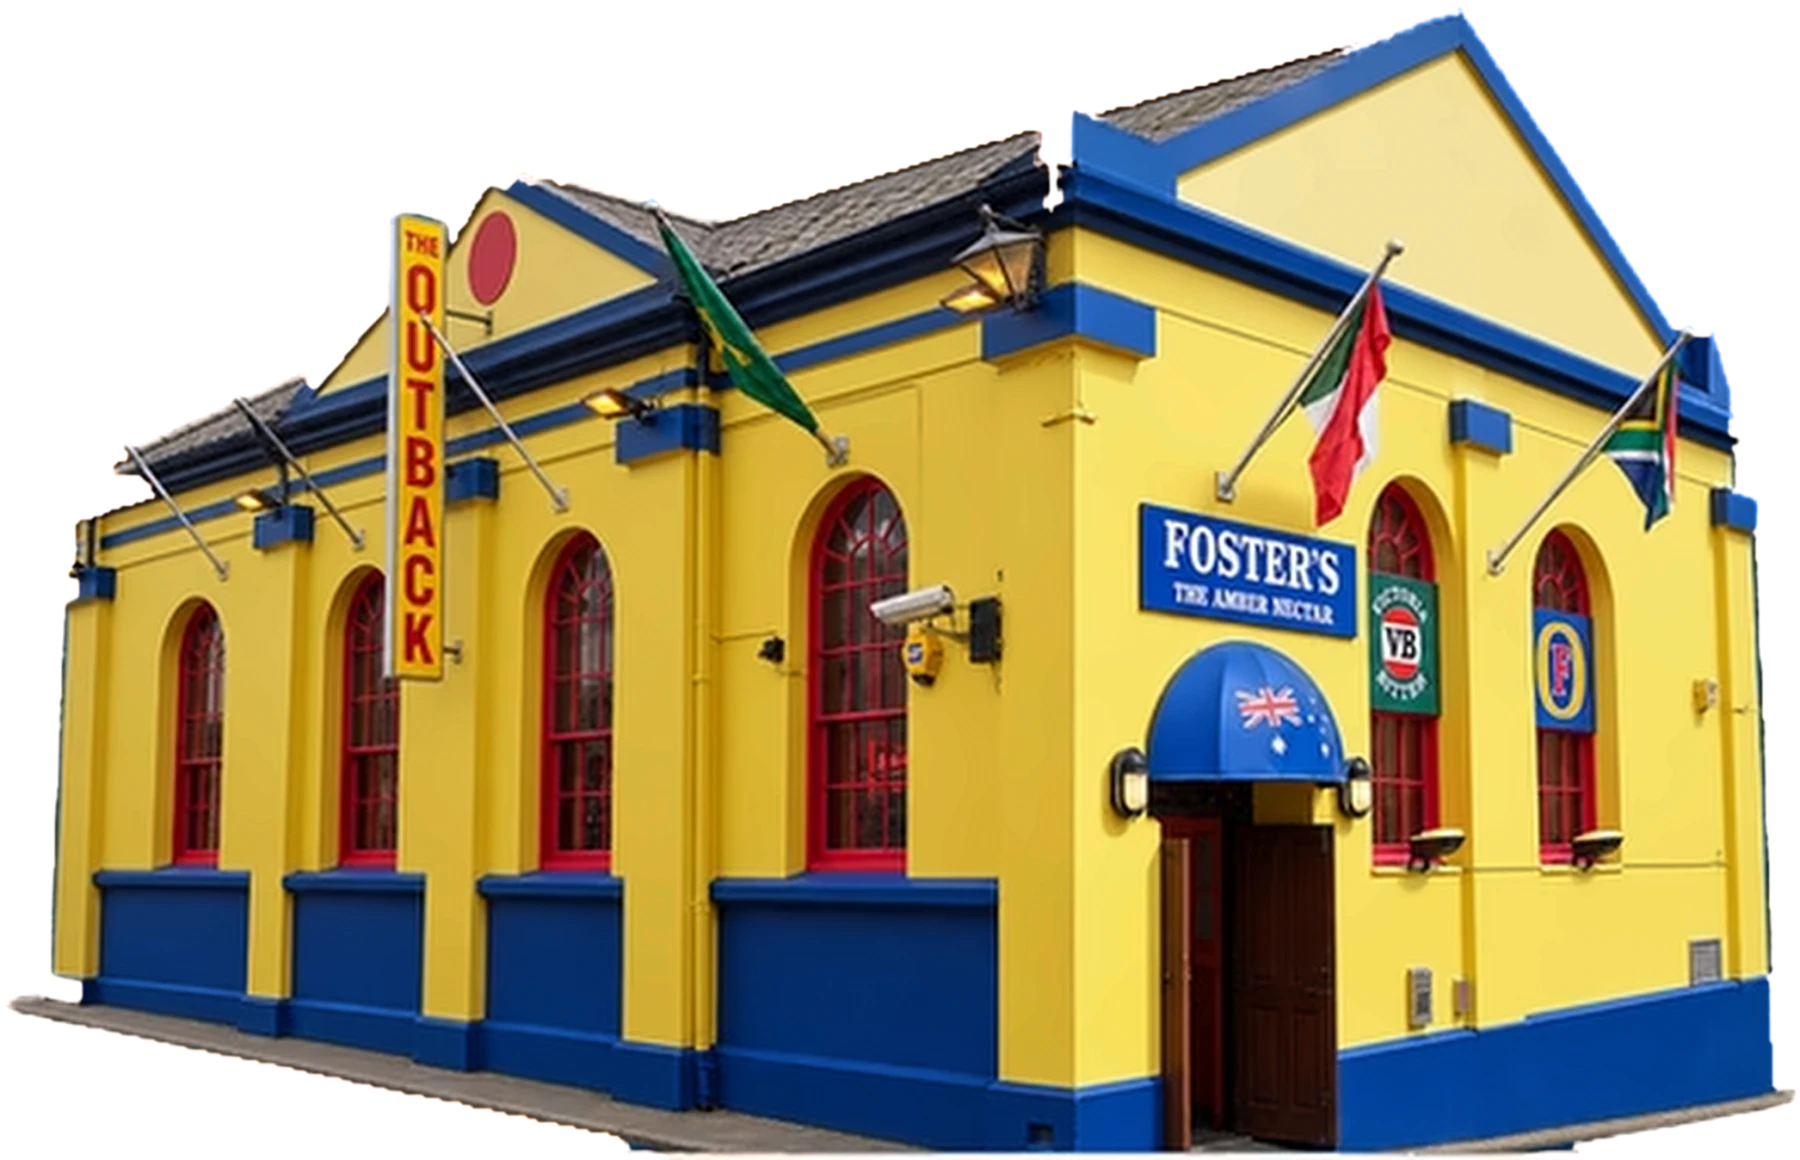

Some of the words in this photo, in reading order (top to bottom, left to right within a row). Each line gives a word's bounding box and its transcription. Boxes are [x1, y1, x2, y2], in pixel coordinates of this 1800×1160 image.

[405, 229, 439, 258] THE
[404, 263, 437, 666] OUTBACK
[1163, 519, 1341, 596] FOSTER'S
[1173, 581, 1209, 607] THE
[1211, 588, 1269, 615] AMBER
[1271, 595, 1334, 625] NECTAR
[1384, 626, 1418, 660] VB
[1551, 642, 1573, 696] F
